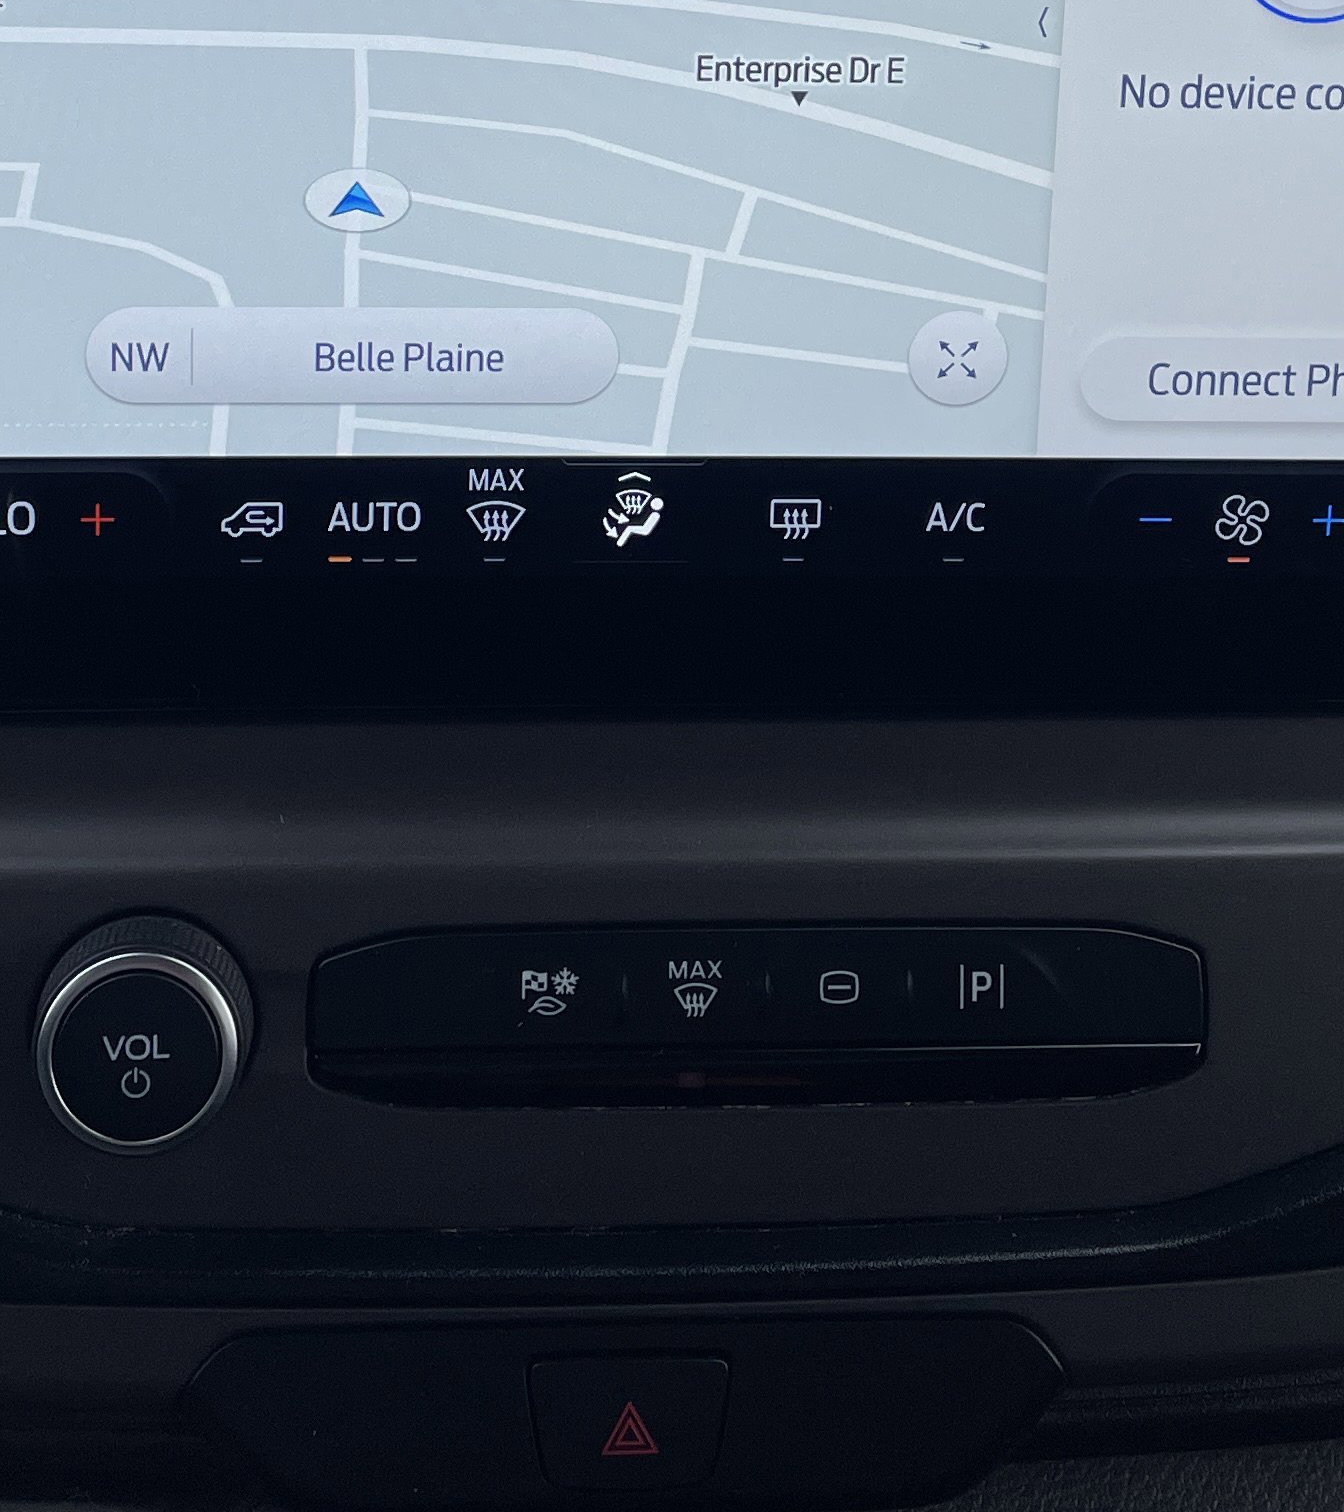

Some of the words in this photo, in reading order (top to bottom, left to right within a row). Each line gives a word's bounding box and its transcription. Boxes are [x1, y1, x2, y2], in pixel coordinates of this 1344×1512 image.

[696, 56, 842, 90] Enterprise
[849, 57, 881, 84] Dr
[887, 58, 904, 84] E
[1119, 74, 1170, 110] No
[1179, 75, 1295, 112] device
[111, 343, 170, 373] NW
[314, 344, 394, 373] Belle
[403, 345, 505, 374] Plaine
[1147, 363, 1296, 399] Connect
[468, 468, 524, 491] MAX
[328, 502, 421, 531] AUTO
[926, 502, 986, 532] A/C
[668, 960, 723, 980] MAX
[103, 1035, 170, 1061] VOL
